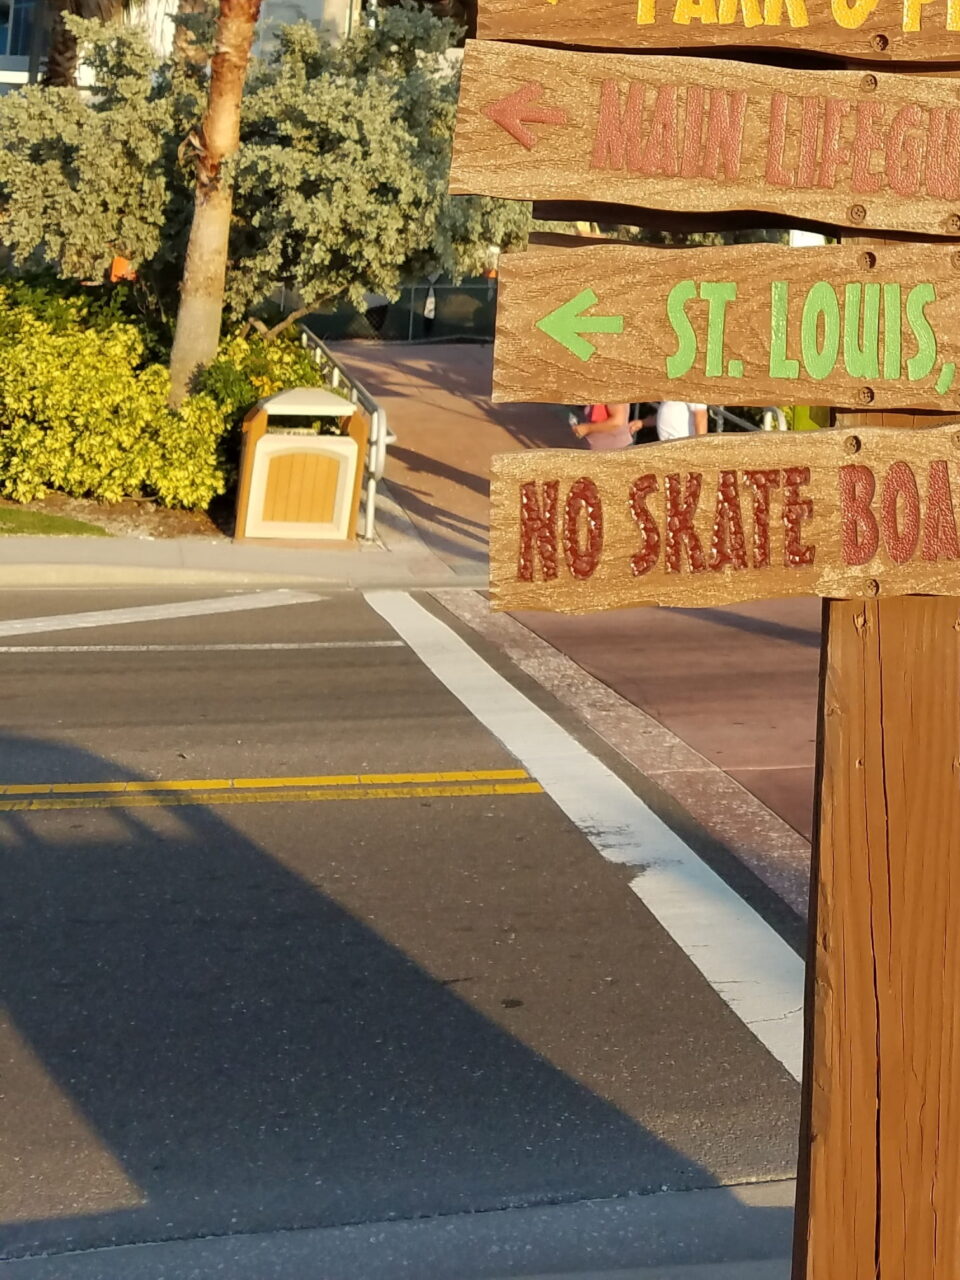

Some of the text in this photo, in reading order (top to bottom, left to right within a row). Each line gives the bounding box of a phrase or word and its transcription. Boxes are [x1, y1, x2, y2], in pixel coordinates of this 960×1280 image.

[591, 80, 748, 181] MAIN
[666, 280, 744, 379] ST.
[769, 282, 955, 394] LOUIS,
[516, 477, 602, 583] NO
[630, 467, 816, 576] SKATE
